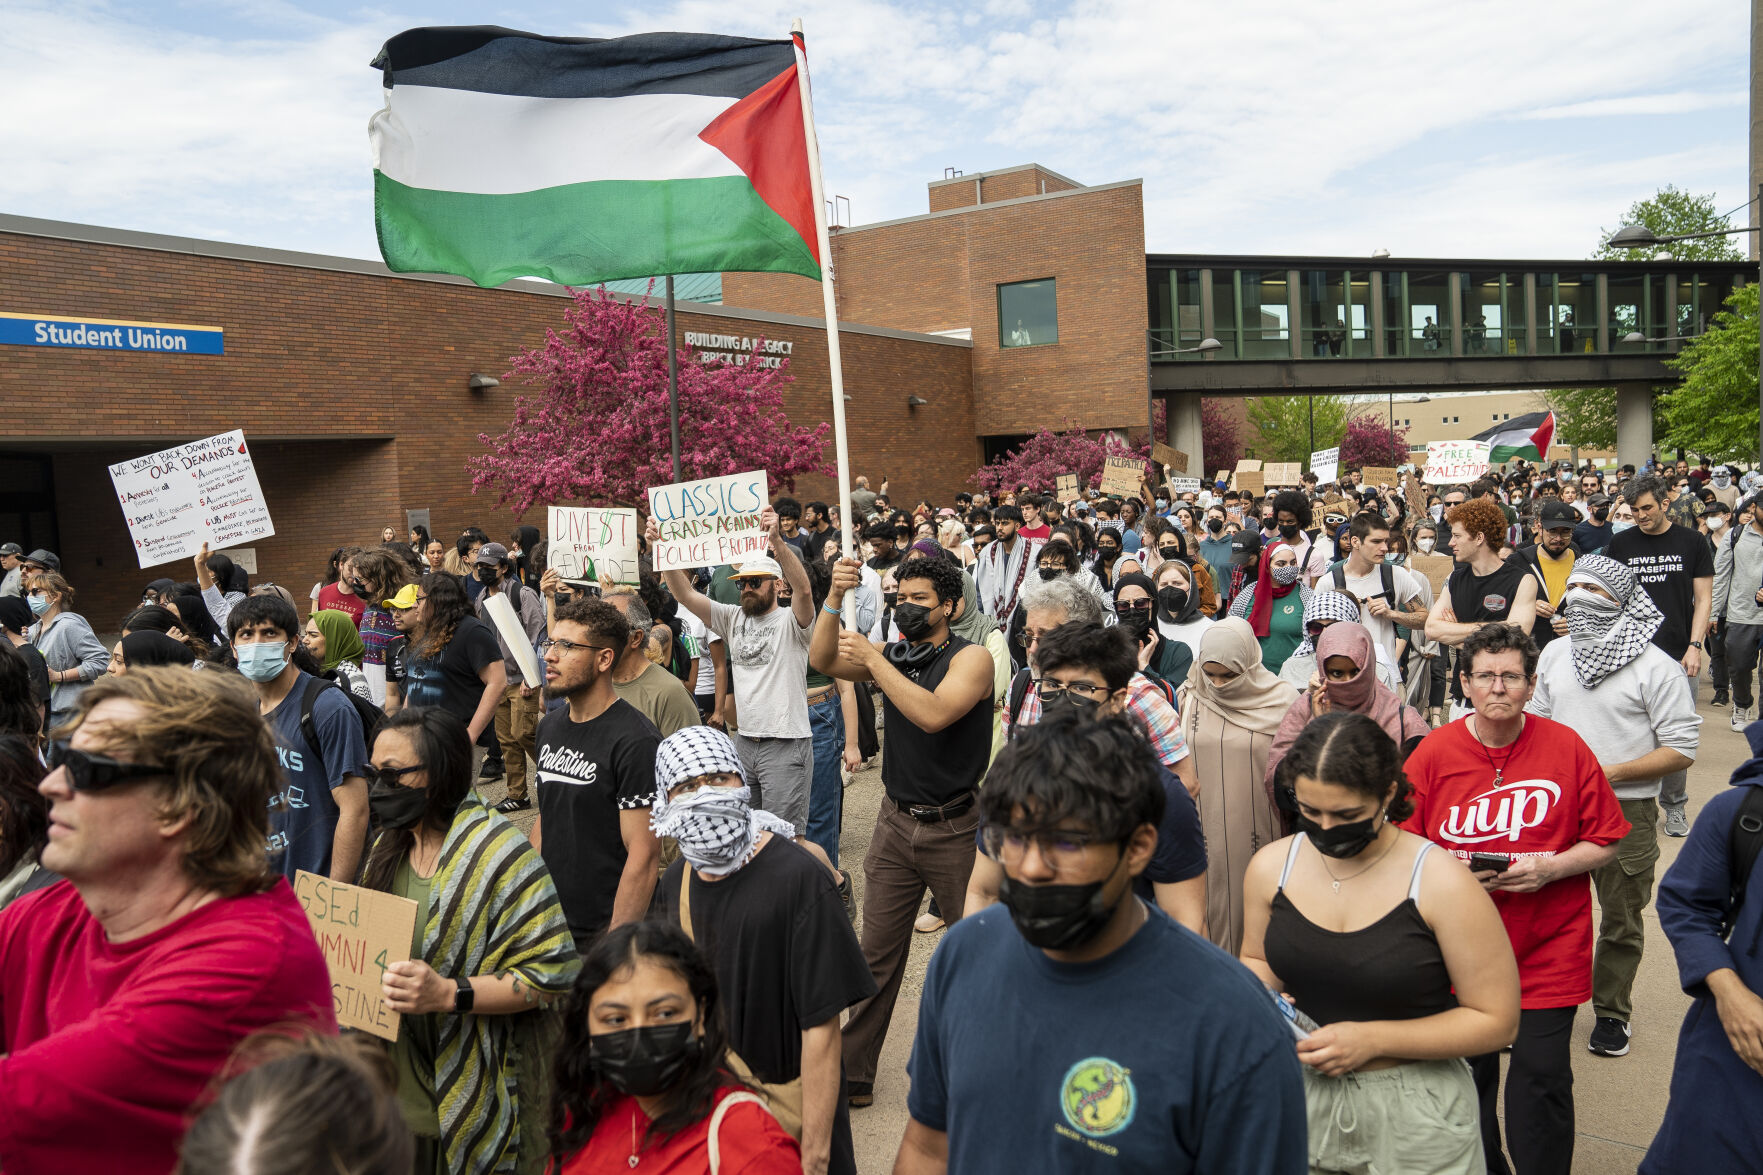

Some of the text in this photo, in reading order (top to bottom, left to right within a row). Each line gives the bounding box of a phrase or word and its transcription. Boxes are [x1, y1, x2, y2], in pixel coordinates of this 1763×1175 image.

[34, 322, 187, 351] Student Union
[684, 332, 793, 354] BUILDING A LGACY
[111, 464, 128, 477] WE
[159, 448, 184, 463] BACK
[184, 440, 210, 455] DOWN
[211, 436, 237, 448] FROM
[150, 446, 235, 479] OUR DEMANDS
[1444, 449, 1473, 460] FREE
[127, 489, 153, 503] Amnesty
[161, 482, 170, 491] all
[653, 481, 760, 522] CLASSICS
[135, 513, 155, 525] Divest
[659, 518, 713, 543] GRADS
[573, 543, 595, 553] FROM
[656, 540, 711, 570] POLICE
[1627, 554, 1682, 566] JEWS SAY:
[1640, 573, 1667, 583] NOW
[326, 601, 357, 612] ODYSSEY
[538, 743, 598, 780] Palestine
[1448, 788, 1550, 843] uup
[374, 948, 389, 985] 4
